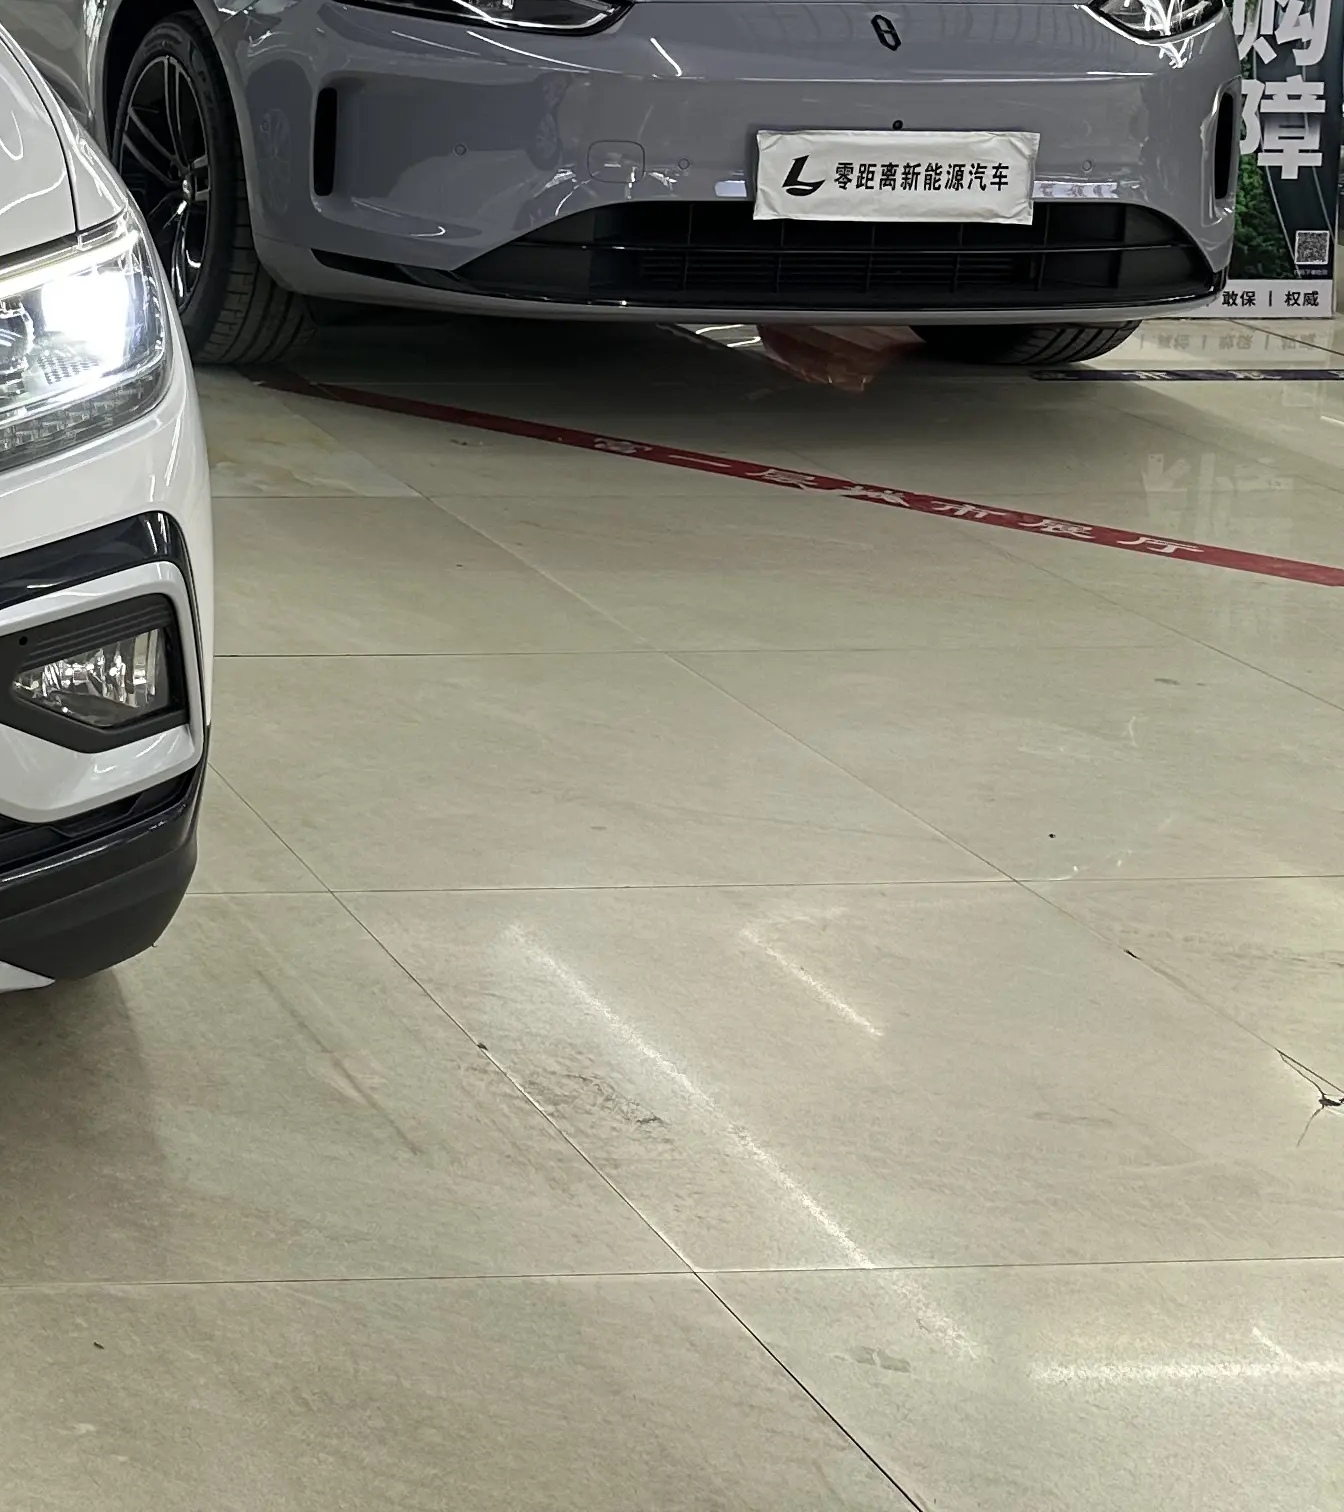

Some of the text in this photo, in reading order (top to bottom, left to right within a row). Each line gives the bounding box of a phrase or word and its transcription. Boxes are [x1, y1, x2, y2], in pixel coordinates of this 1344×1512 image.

[1239, 74, 1326, 179] 障
[833, 161, 1010, 192] 零距离新能源汽车
[1221, 290, 1320, 308] 敢保 权威
